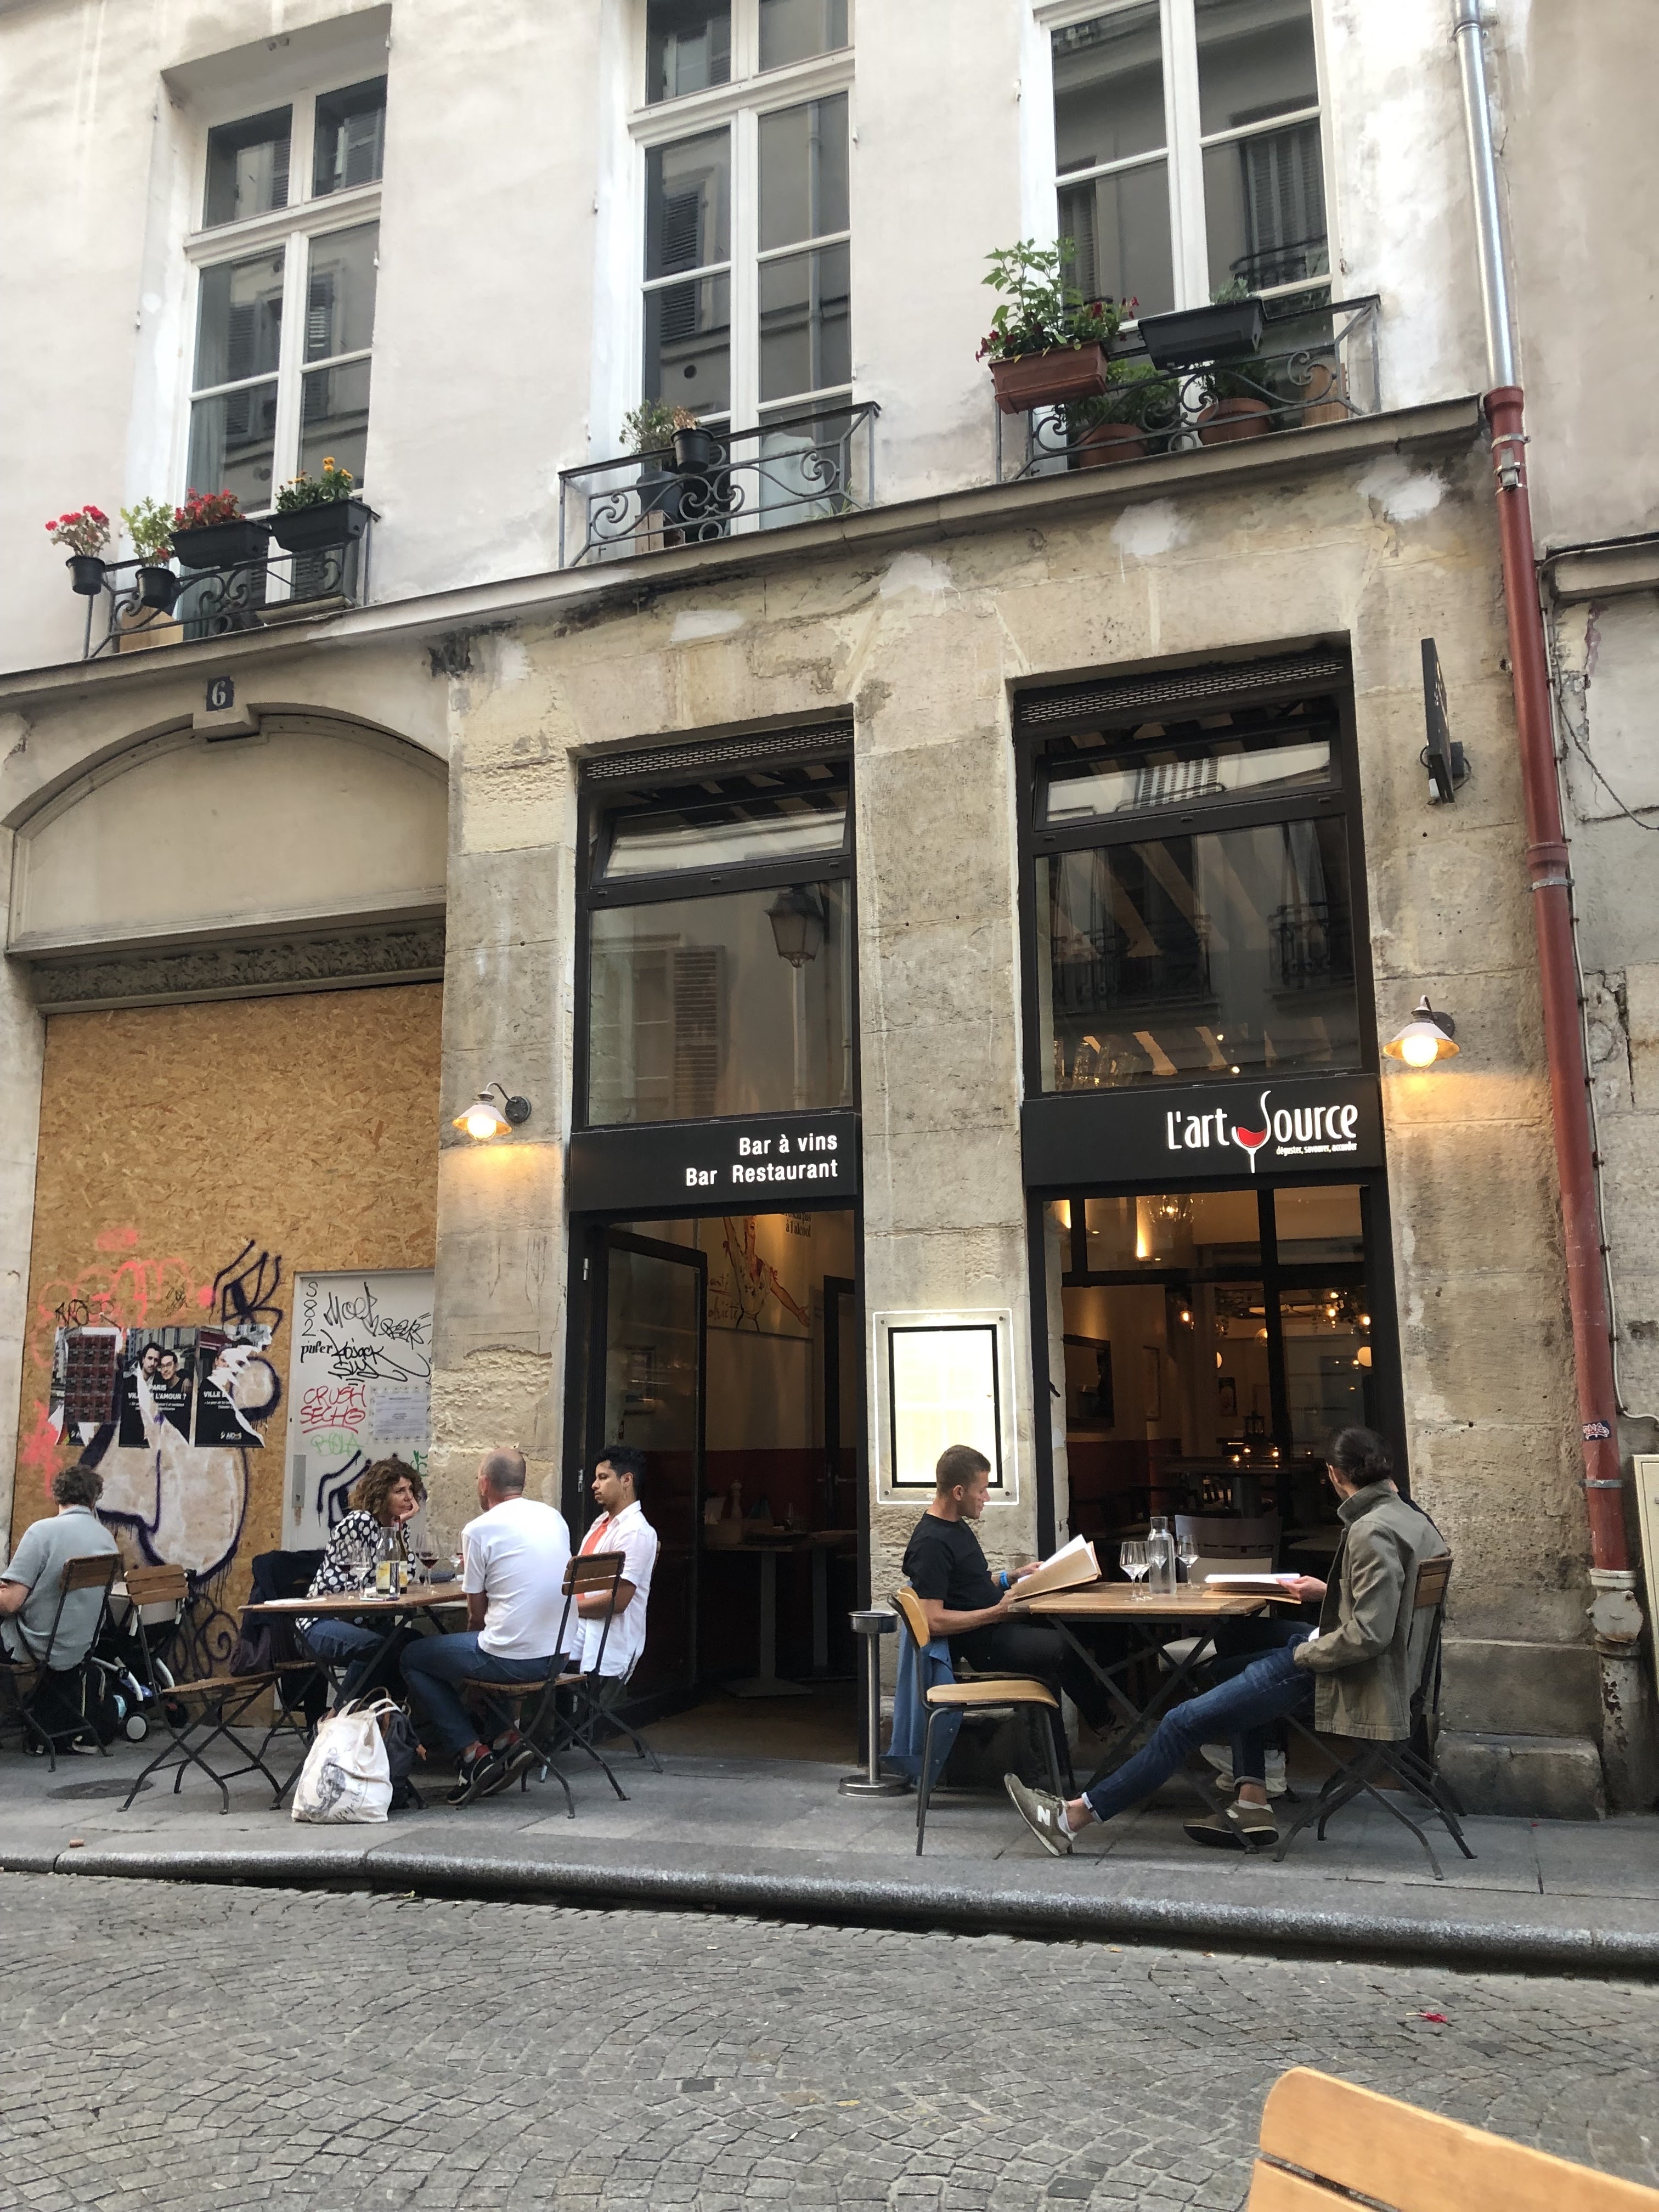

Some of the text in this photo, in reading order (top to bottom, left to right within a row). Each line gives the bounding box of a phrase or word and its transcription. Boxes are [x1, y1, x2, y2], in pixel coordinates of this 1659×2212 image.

[211, 680, 226, 707] 6
[1166, 1108, 1231, 1149] L'art
[740, 1132, 838, 1156] Bar à vins
[686, 1159, 838, 1186] Bar Restaurant
[303, 1384, 367, 1408] CRUSH
